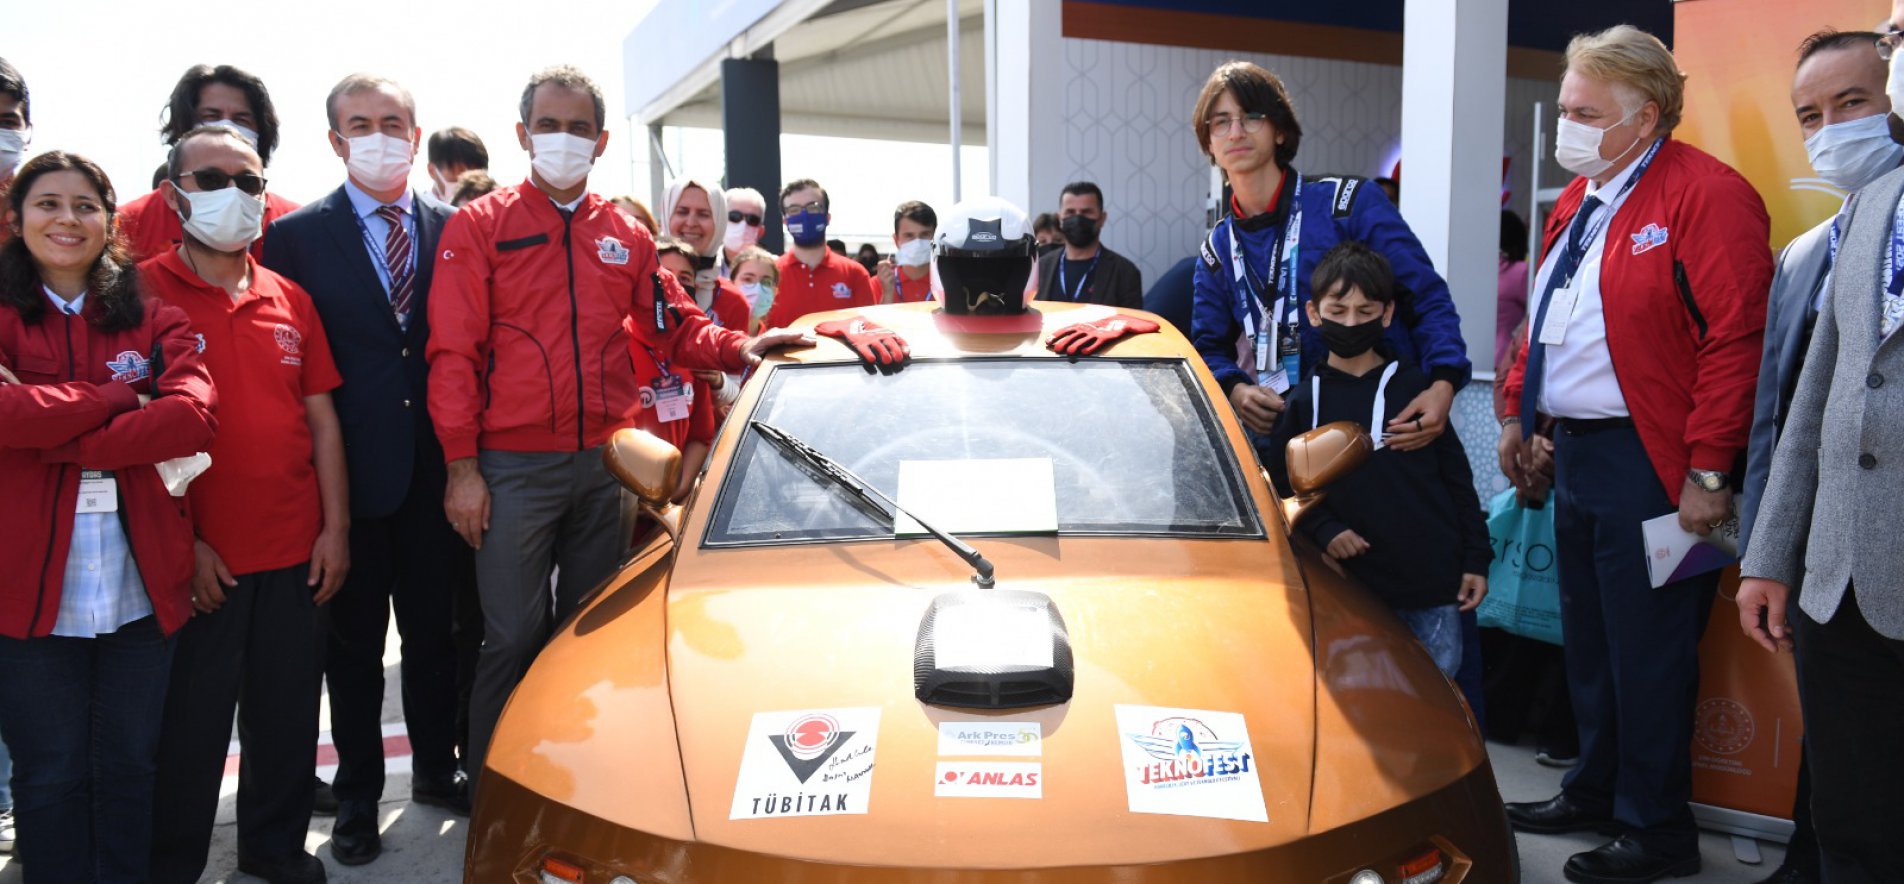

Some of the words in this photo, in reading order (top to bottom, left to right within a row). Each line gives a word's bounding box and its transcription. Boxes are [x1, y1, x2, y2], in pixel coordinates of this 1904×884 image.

[958, 731, 981, 740] Ark
[984, 731, 1016, 740] Pres
[1137, 752, 1250, 785] TEKNOFEST
[966, 771, 1039, 786] ANLAS
[752, 792, 848, 815] TÜBİTAK
